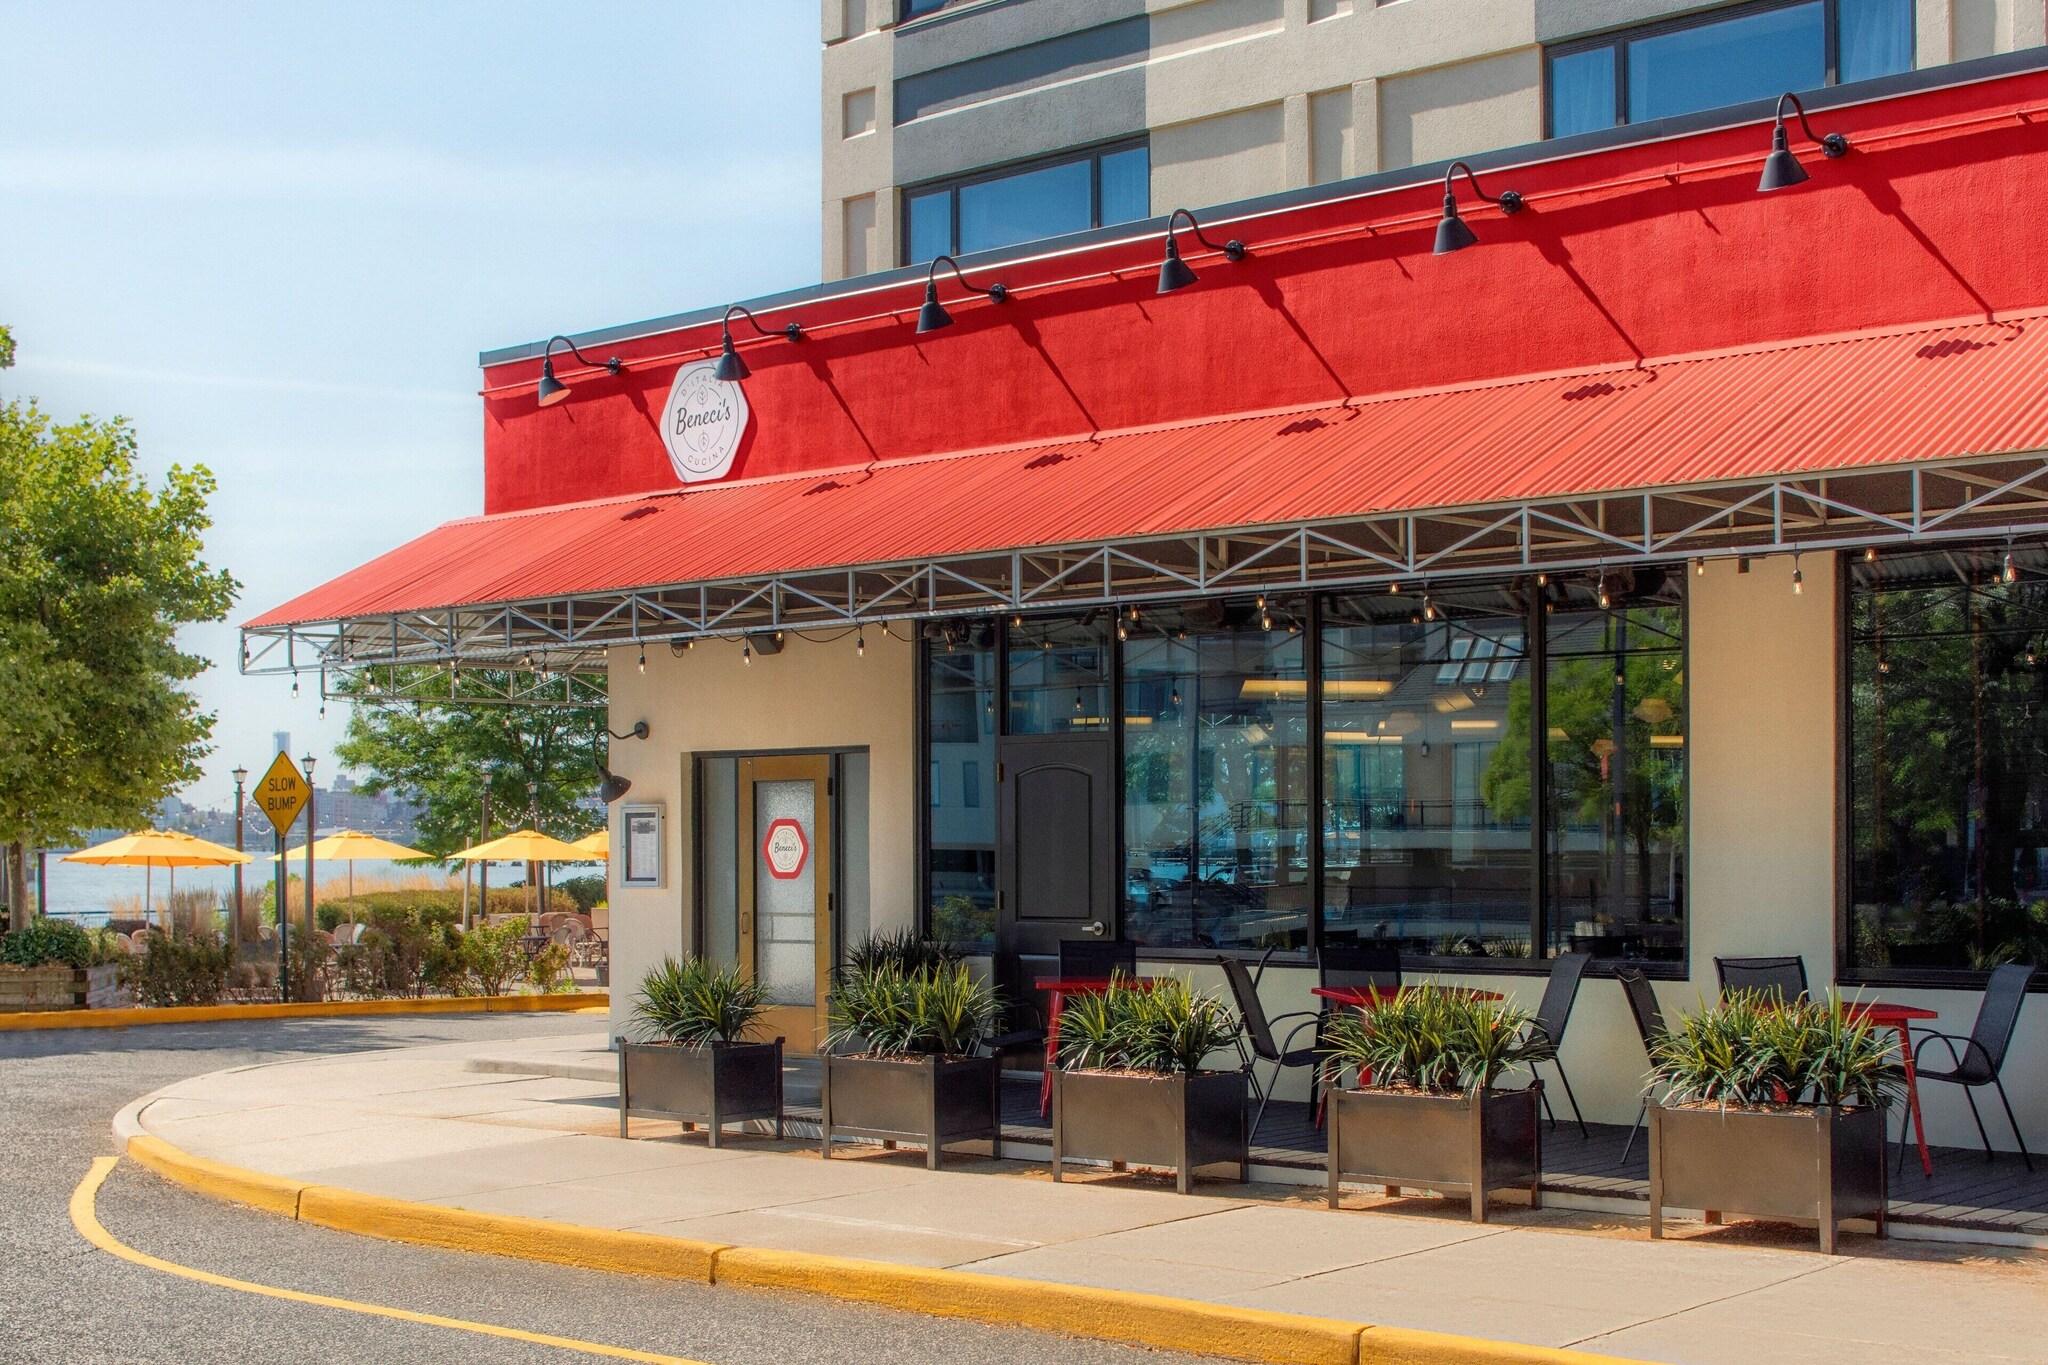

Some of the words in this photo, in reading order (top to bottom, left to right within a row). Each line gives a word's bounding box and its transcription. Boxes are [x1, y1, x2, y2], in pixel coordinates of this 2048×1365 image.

[675, 398, 731, 435] Beneci's
[687, 446, 725, 466] CUCINA
[268, 777, 296, 792] SLOW
[267, 796, 297, 811] BUMP
